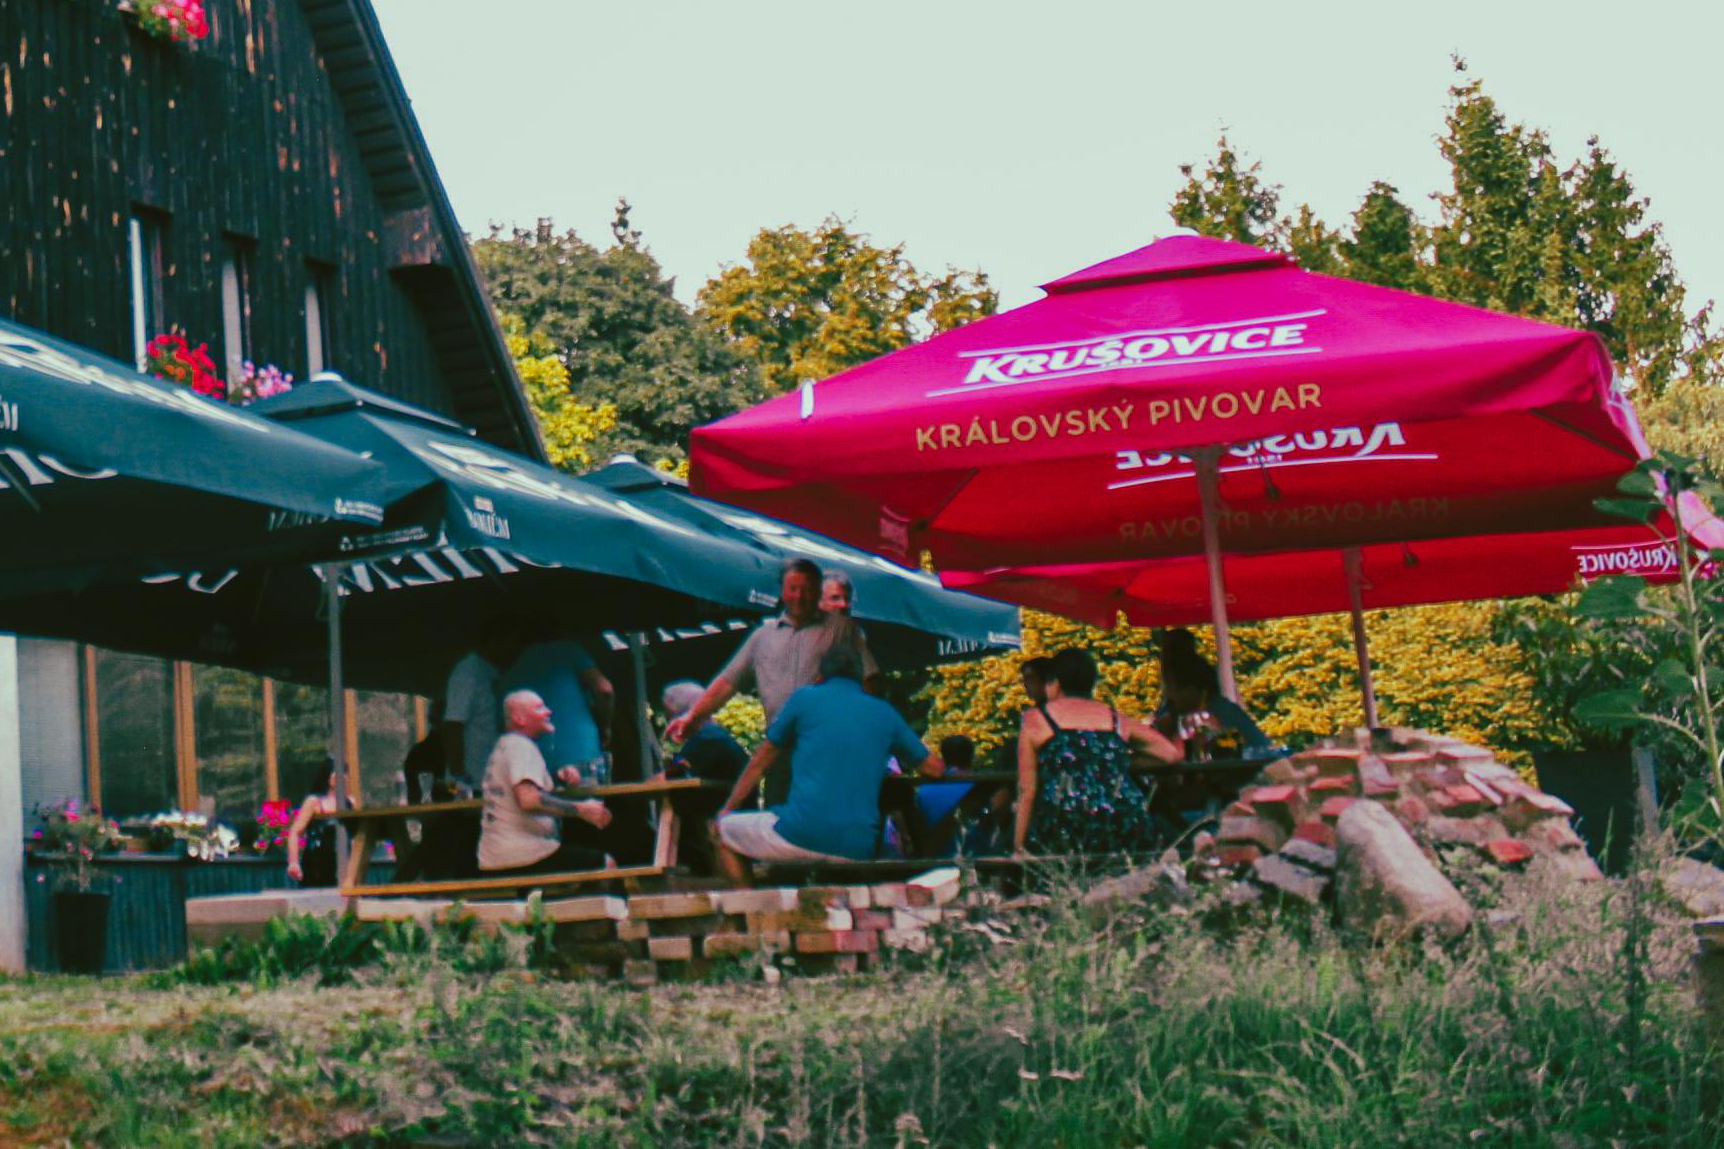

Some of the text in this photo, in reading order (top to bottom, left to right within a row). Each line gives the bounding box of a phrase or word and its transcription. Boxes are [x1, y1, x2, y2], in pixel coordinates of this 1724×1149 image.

[962, 324, 1307, 384] KRUŠOVICE
[916, 383, 1323, 452] KRÁLOVSKÝ PIVOVAR
